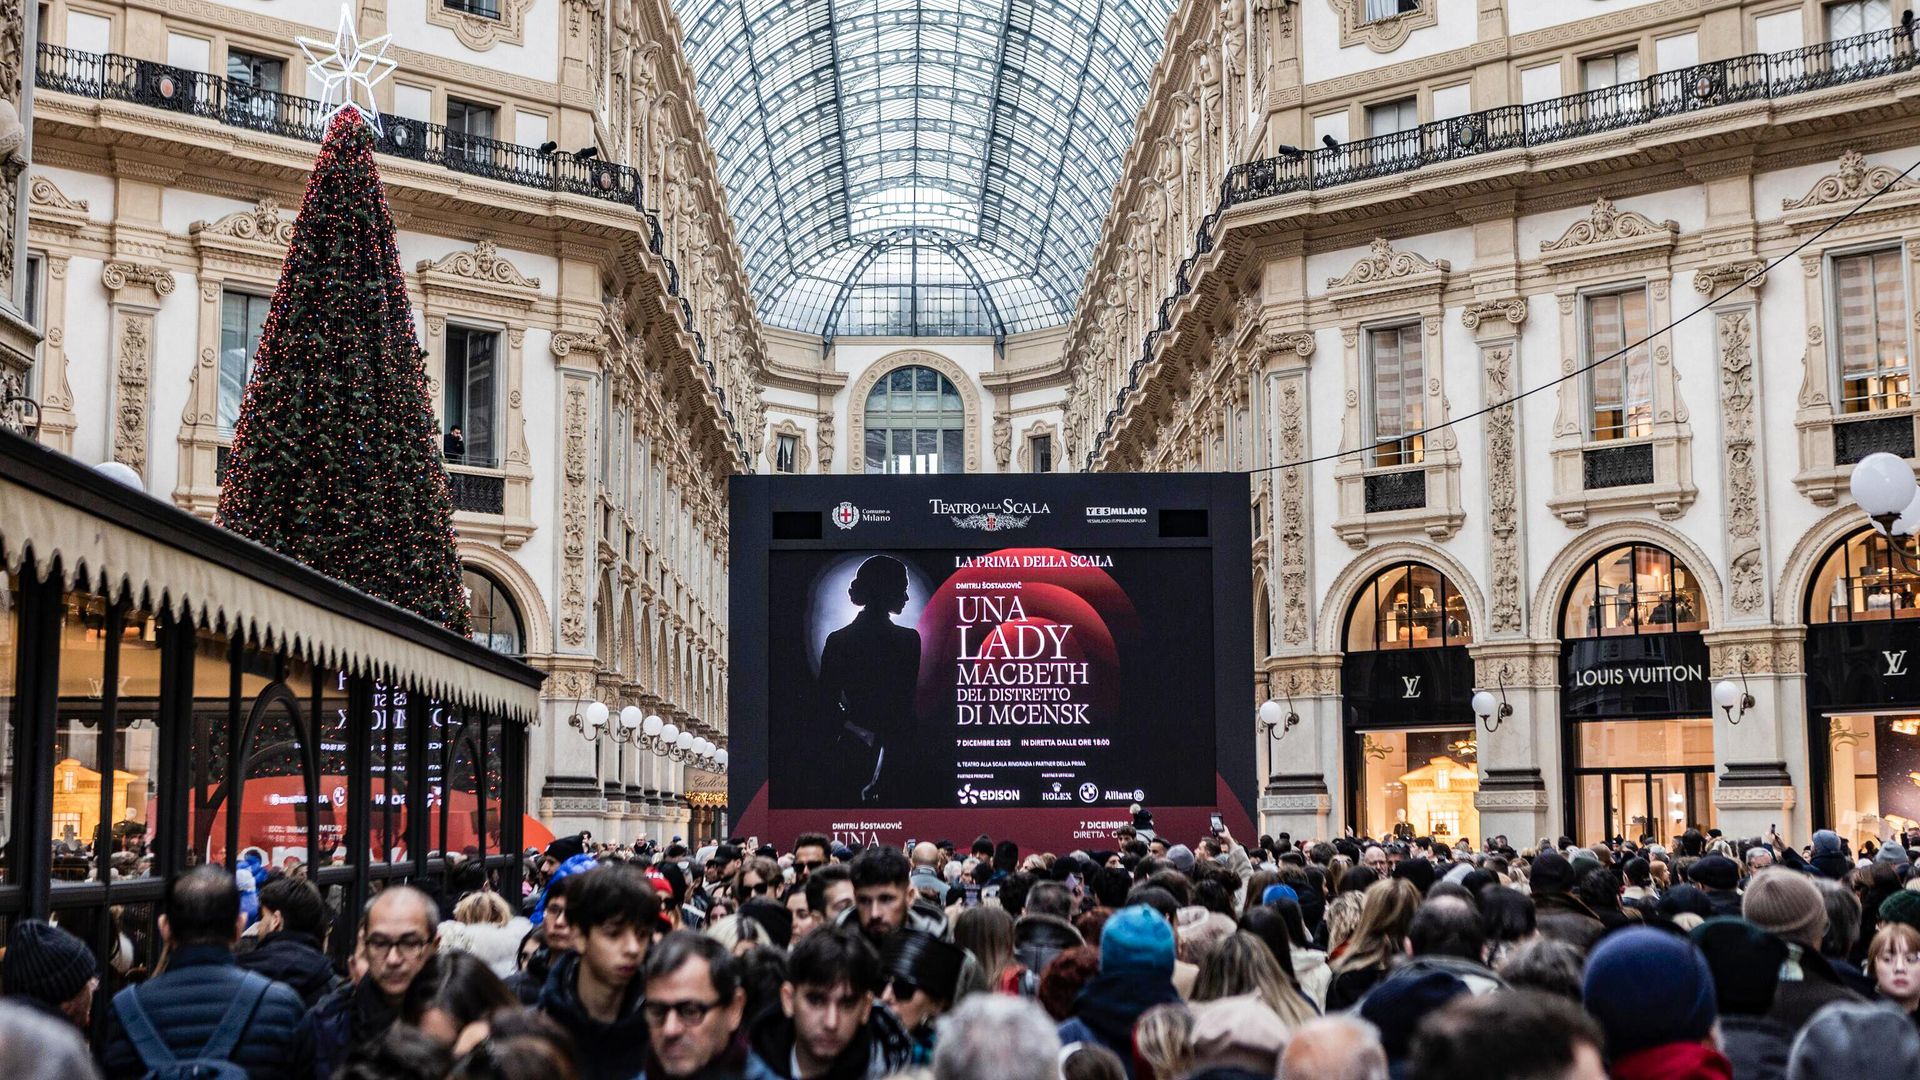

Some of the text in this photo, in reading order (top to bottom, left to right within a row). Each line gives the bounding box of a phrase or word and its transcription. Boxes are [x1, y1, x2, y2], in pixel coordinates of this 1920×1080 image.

[928, 499, 980, 515] TEATRO
[1002, 498, 1051, 514] SCALA
[862, 514, 891, 522] Milano
[955, 555, 1114, 568] LA PRIMA DELLA SCALA
[955, 581, 1023, 590] DMITRIJ ŠOSTAKOVIČ
[955, 595, 1029, 623] UNA
[956, 624, 1073, 660] LADY
[956, 662, 1089, 686] MACBETH
[1576, 664, 1702, 686] LOUIS VUITTON
[956, 687, 1071, 702] DEL DISTRETTO
[956, 703, 1091, 726] DI MCENSK
[956, 739, 1011, 747] 7 DICEMBRE 2025
[1057, 738, 1077, 746] DALLE
[1078, 738, 1092, 746] ORE
[1093, 738, 1110, 746] 18:00
[1042, 792, 1072, 801] ROLEX
[1104, 790, 1133, 801] Allianz
[860, 821, 903, 830] ŠOSTAKOVIČ
[1080, 821, 1086, 829] 7
[1073, 831, 1105, 839] DIRETTA
